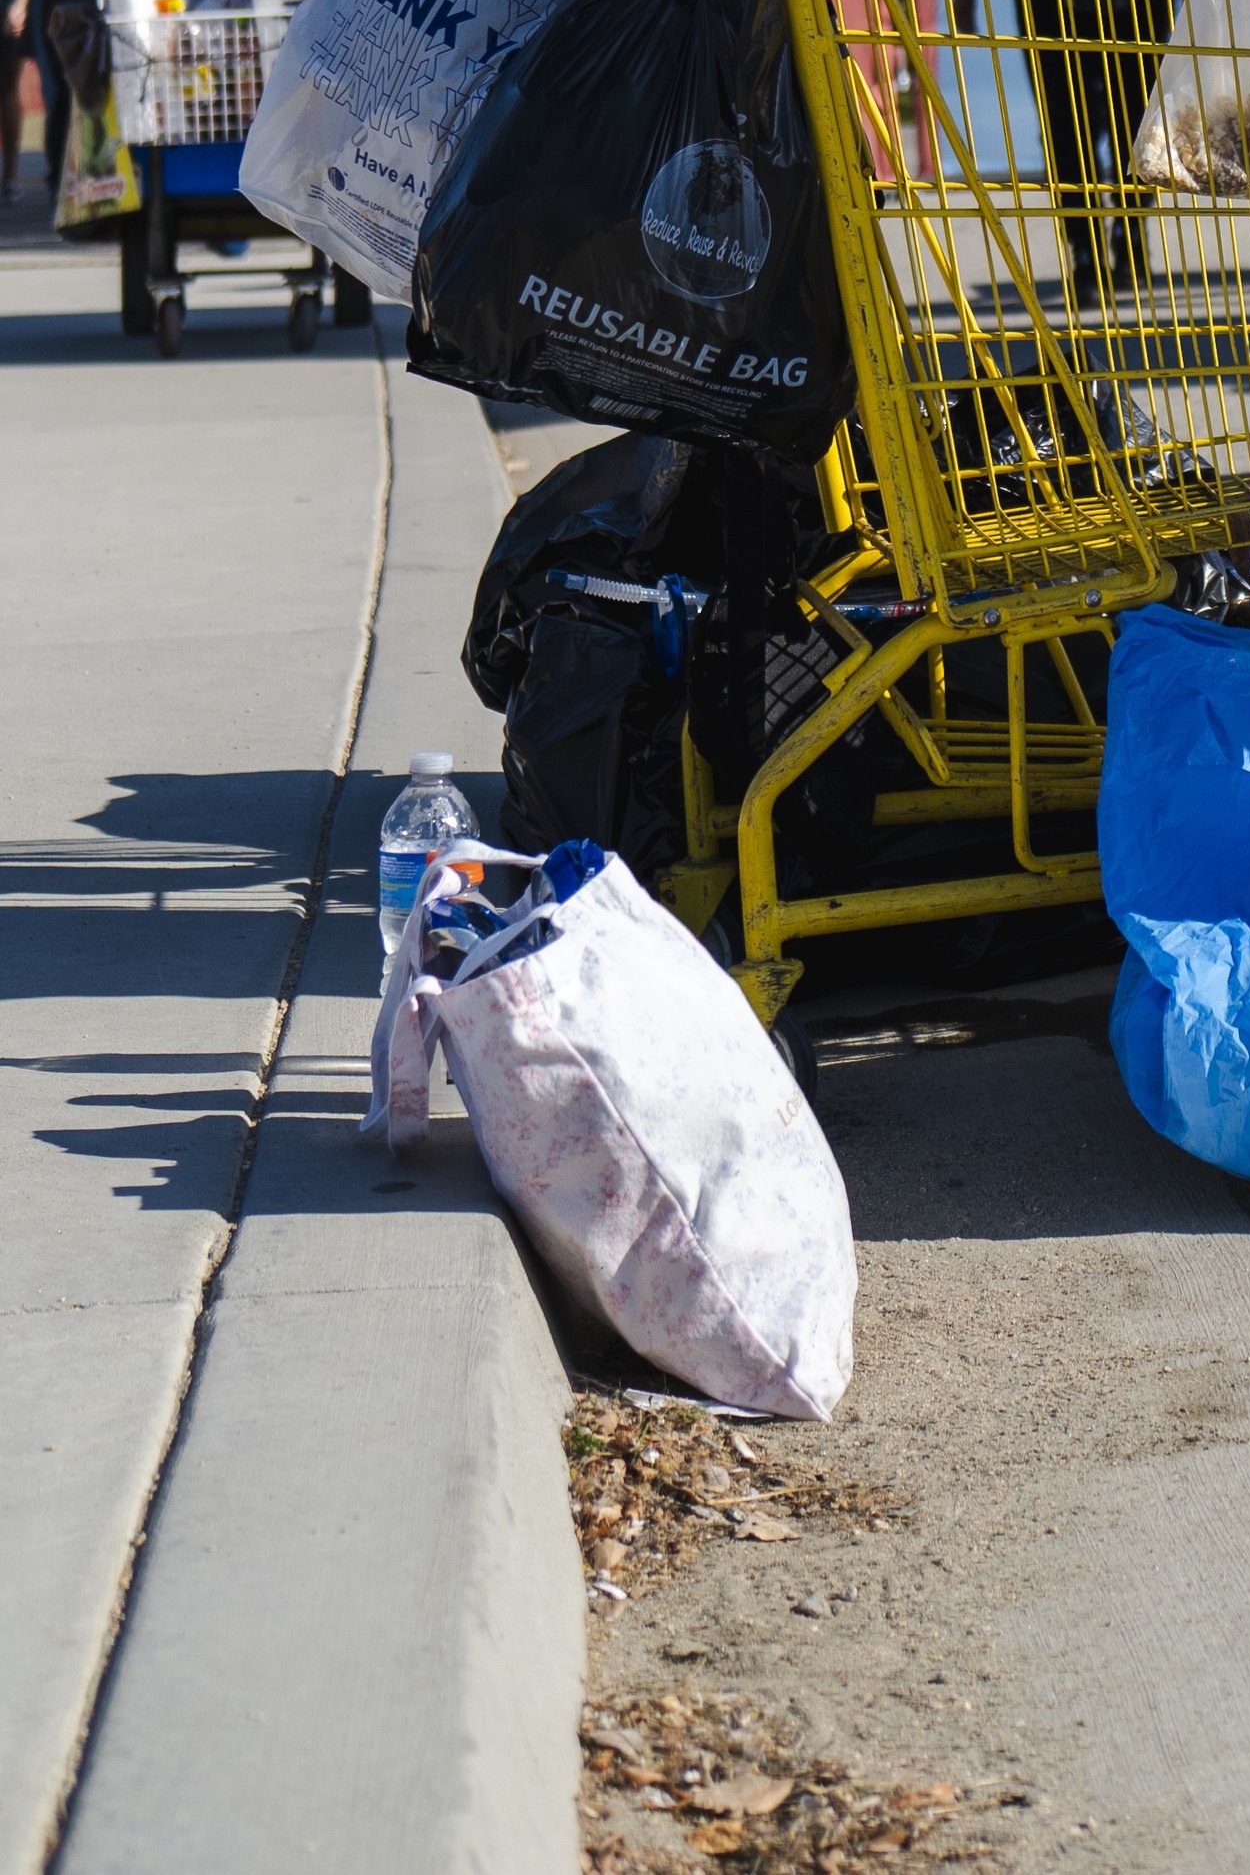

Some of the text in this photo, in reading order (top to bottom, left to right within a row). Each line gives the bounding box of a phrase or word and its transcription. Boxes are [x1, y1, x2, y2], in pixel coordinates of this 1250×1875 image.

[300, 40, 419, 147] THANK
[355, 147, 399, 183] Have
[402, 174, 415, 193] A
[641, 208, 682, 251] Reduce,
[686, 225, 714, 257] Reuse
[716, 235, 729, 263] &
[518, 274, 721, 373] REUSABLE
[729, 353, 808, 387] BAG
[578, 337, 608, 354] RETURN
[609, 349, 620, 359] TO
[626, 355, 680, 379] PARTICIPATING
[679, 374, 704, 387] STORE
[704, 382, 720, 392] FOR
